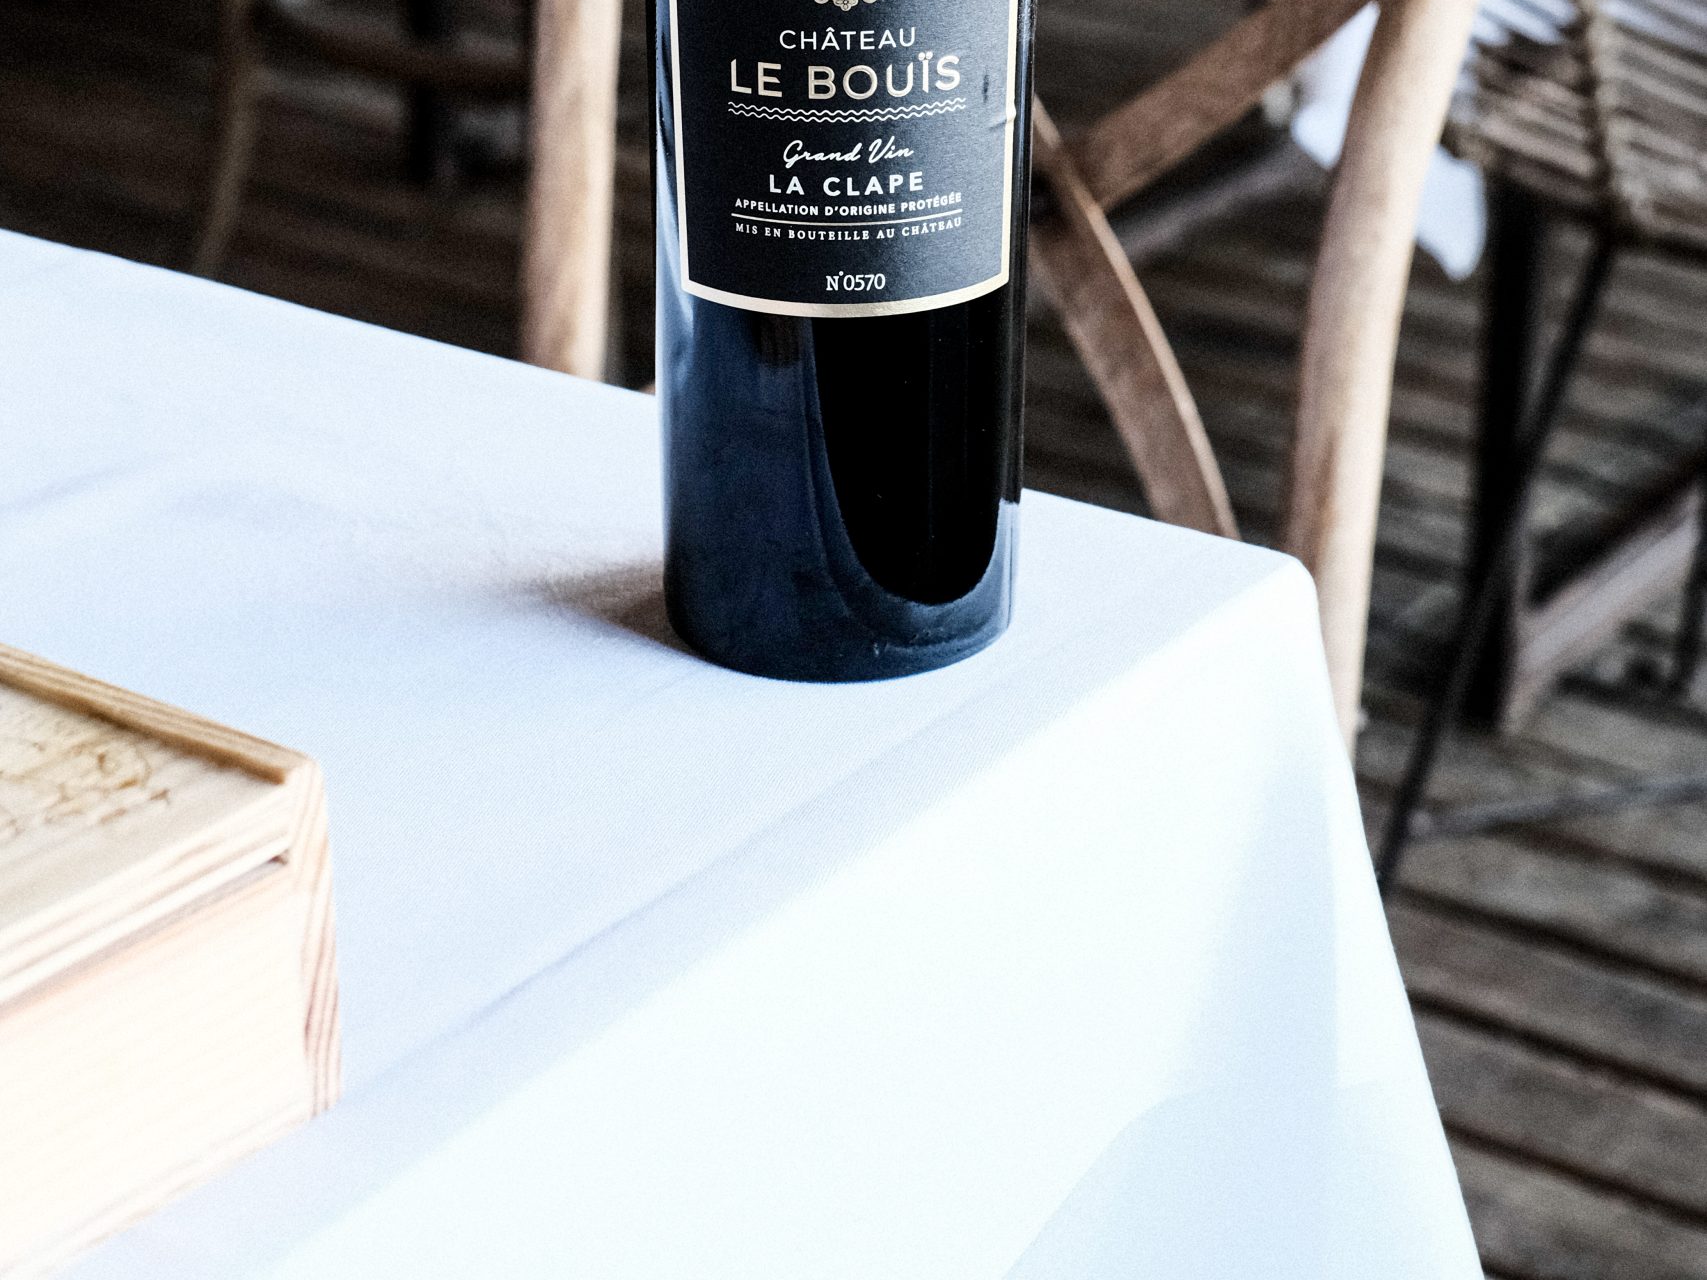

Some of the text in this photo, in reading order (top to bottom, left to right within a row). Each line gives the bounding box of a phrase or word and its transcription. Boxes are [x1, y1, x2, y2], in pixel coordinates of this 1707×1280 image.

[780, 26, 917, 50] CHÂTEAU
[730, 52, 961, 100] LE BOUÏS
[783, 136, 914, 168] Grand Vin
[769, 171, 924, 196] LA CLAPE
[735, 191, 962, 216] APPELLATION D'ORIGINE PROTÉGÉE
[735, 217, 962, 241] MIS EN BOUTEILLE AU CHÂTEAU
